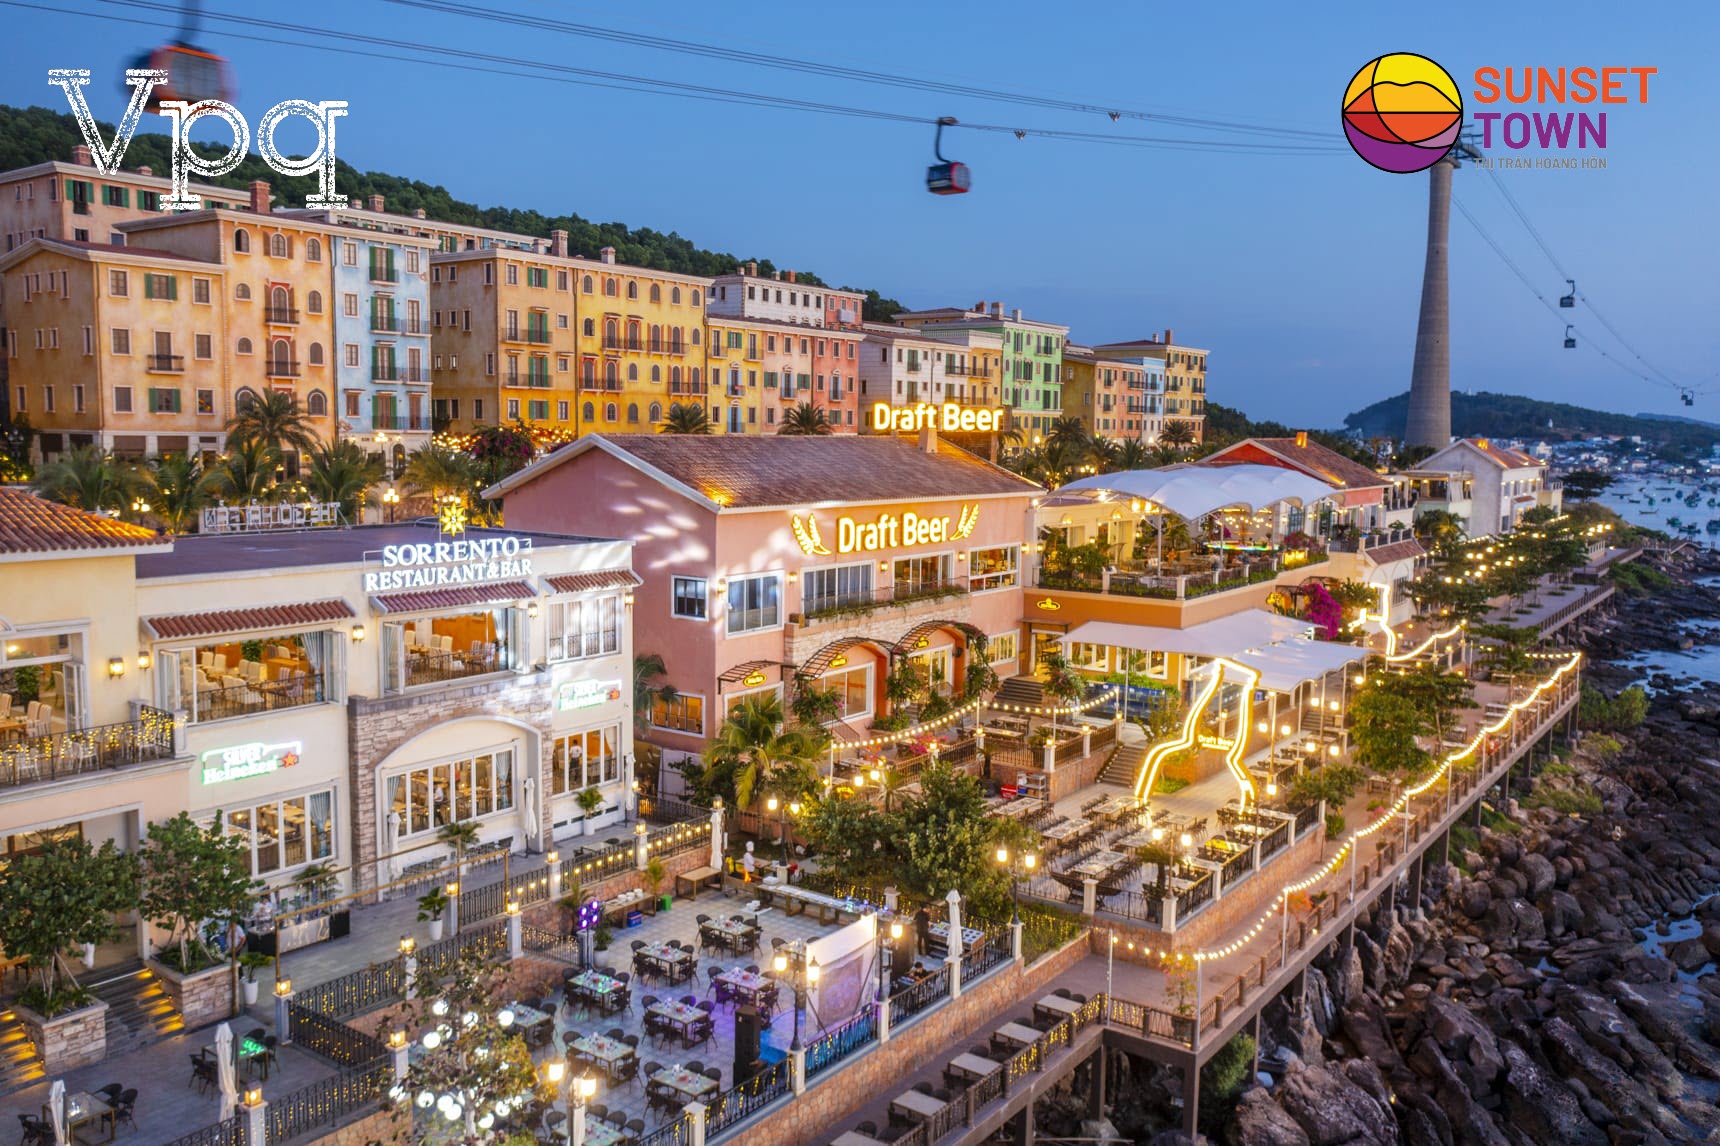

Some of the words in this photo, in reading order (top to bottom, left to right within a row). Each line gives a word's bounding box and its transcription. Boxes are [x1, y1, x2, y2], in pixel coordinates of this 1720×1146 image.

[874, 402, 937, 430] Draft
[943, 402, 1004, 431] Beer
[838, 514, 899, 553] Draft
[903, 512, 950, 546] Beer
[383, 536, 520, 568] SORRENTO
[365, 559, 533, 592] RESTAURANT&BAR
